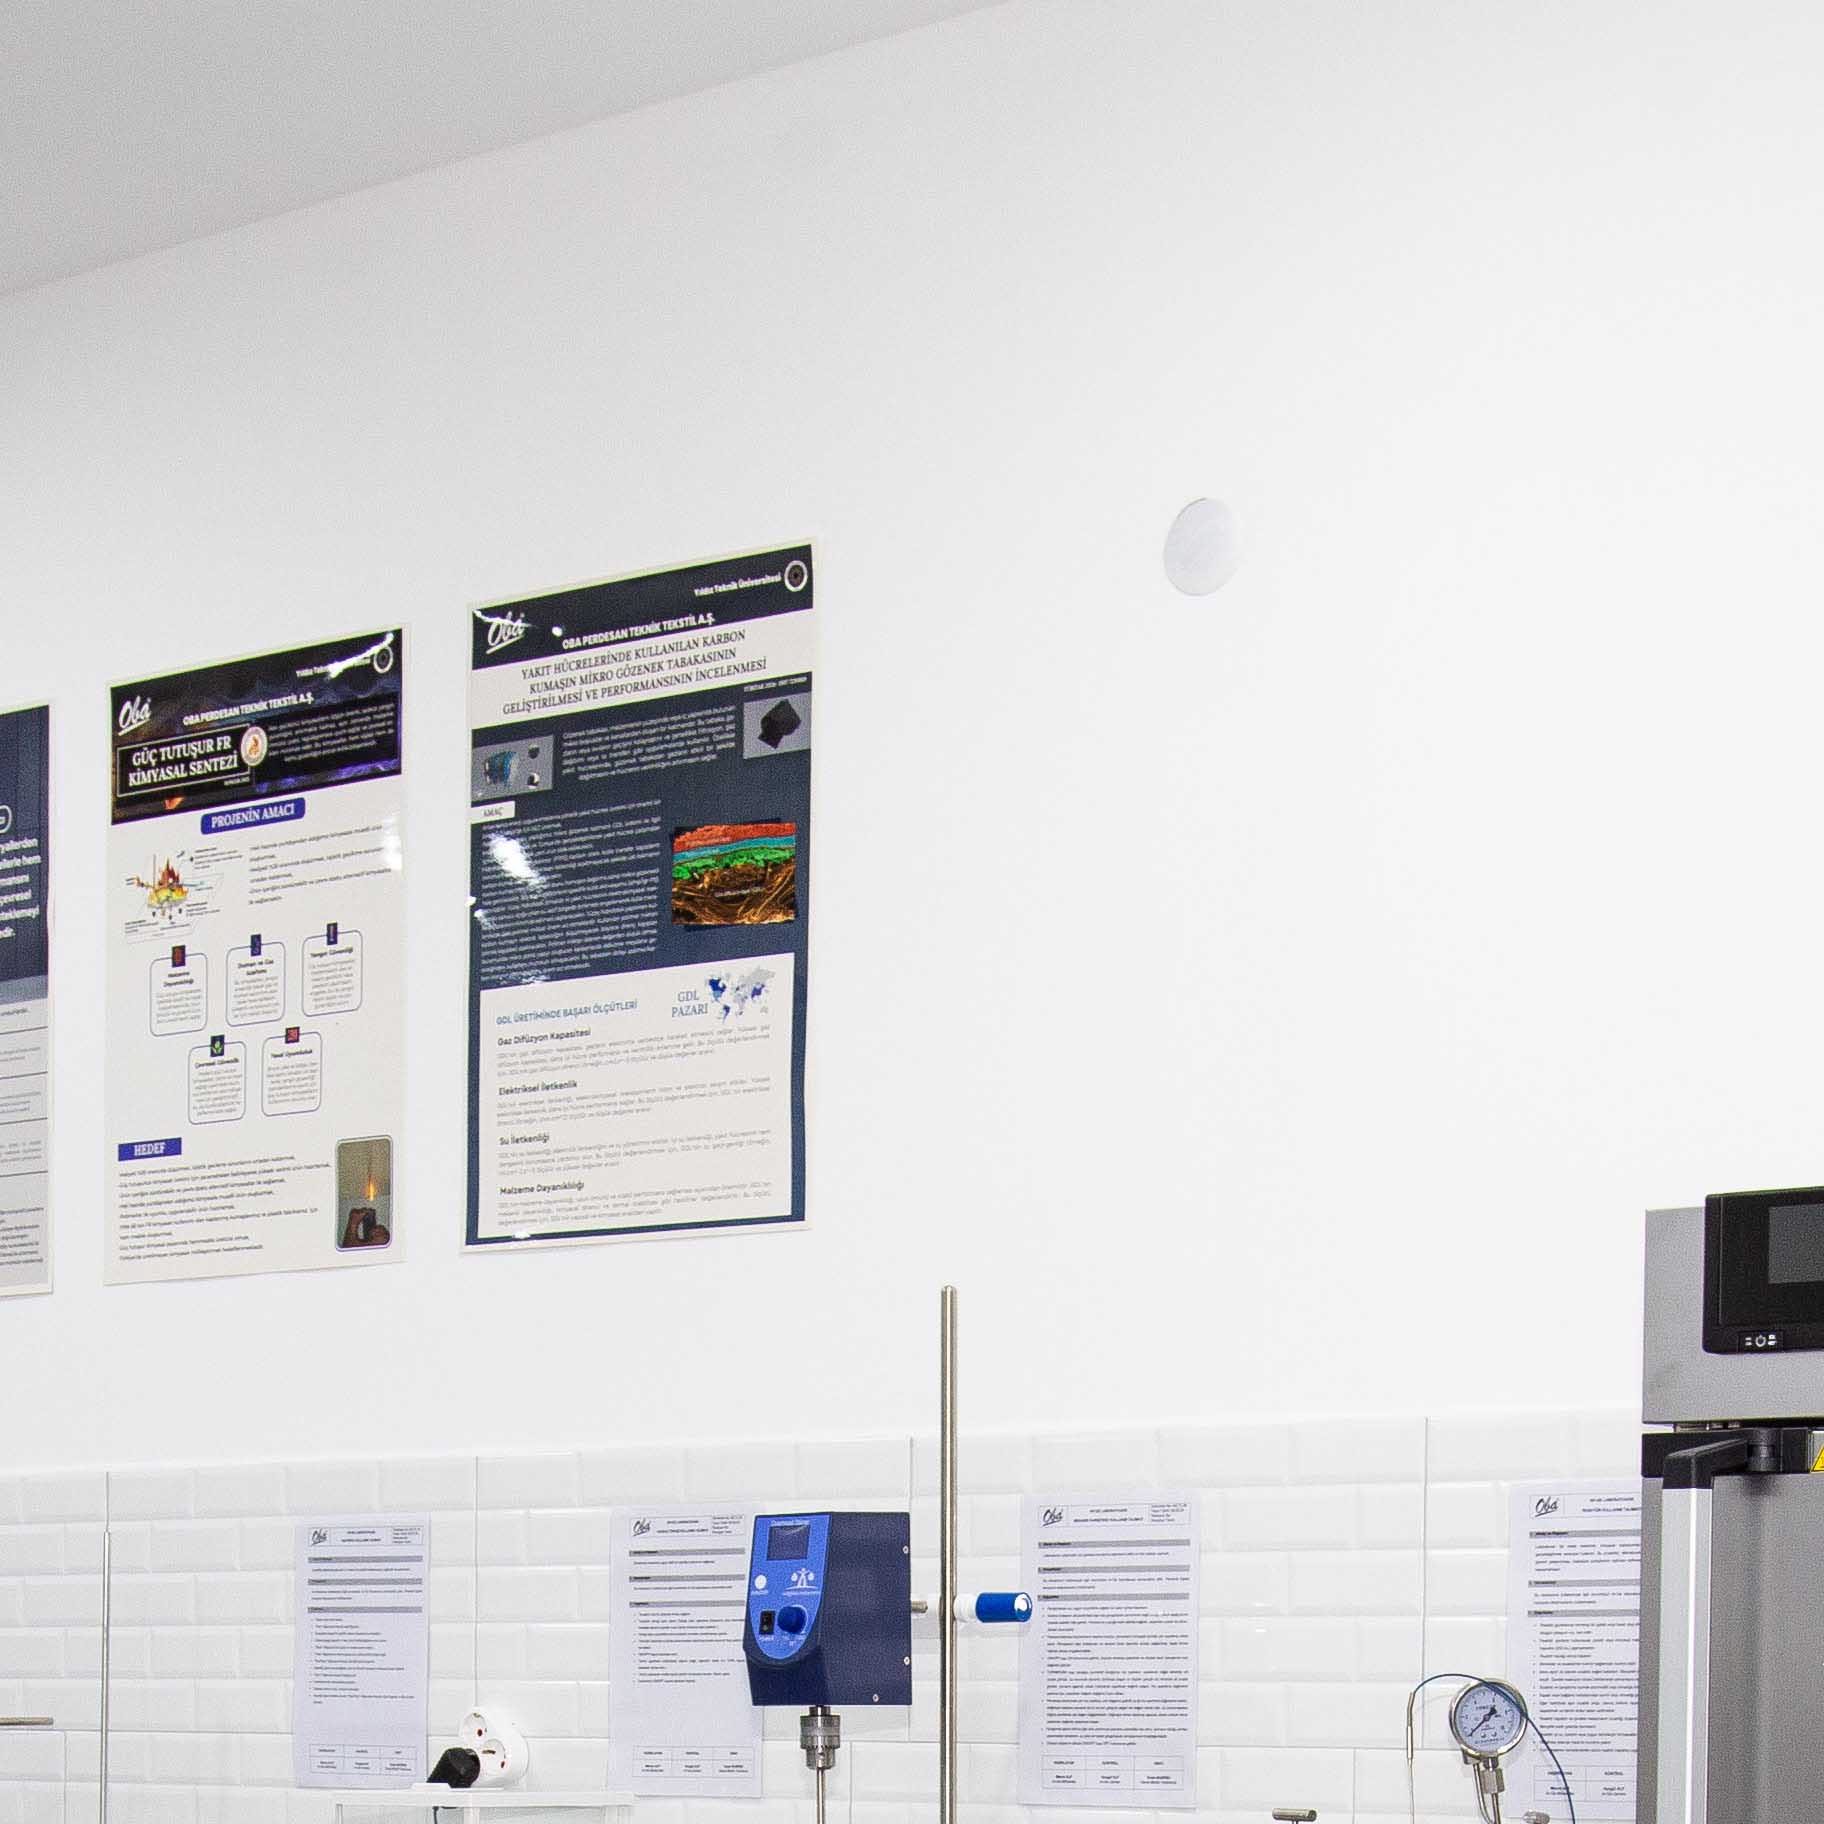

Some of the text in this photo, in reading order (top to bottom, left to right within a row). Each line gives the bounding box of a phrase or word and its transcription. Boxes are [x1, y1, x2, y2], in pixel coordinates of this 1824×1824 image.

[562, 637, 582, 650] OBA
[583, 628, 628, 646] PERDESAN
[629, 620, 662, 638] TEKNİK
[663, 613, 696, 633] TEKSTİL
[521, 629, 746, 680] YAKIT HÜCRELERİNDE KULLANILAN KARBON
[503, 656, 768, 715] GELİŞTİRİLMESİ VE PERFORMANSININ İNCELENMESİ
[530, 647, 737, 695] KUMAŞIN MİKRO GÖZENEK TABAKASININ
[201, 707, 240, 723] PERDESAN
[241, 701, 269, 715] TEKNİK
[269, 694, 297, 711] TEKSTİL
[132, 735, 232, 767] GÜÇ TUTUŞUR FR
[128, 751, 238, 787] KİMYASAL SENTEZİ
[211, 803, 295, 829] PROJENİN AMACI
[592, 1000, 638, 1016] ÖLÇÜTLERİ
[671, 1003, 709, 1018] PAZARI
[677, 990, 700, 1002] GDL
[134, 1141, 166, 1156] HEDEF
